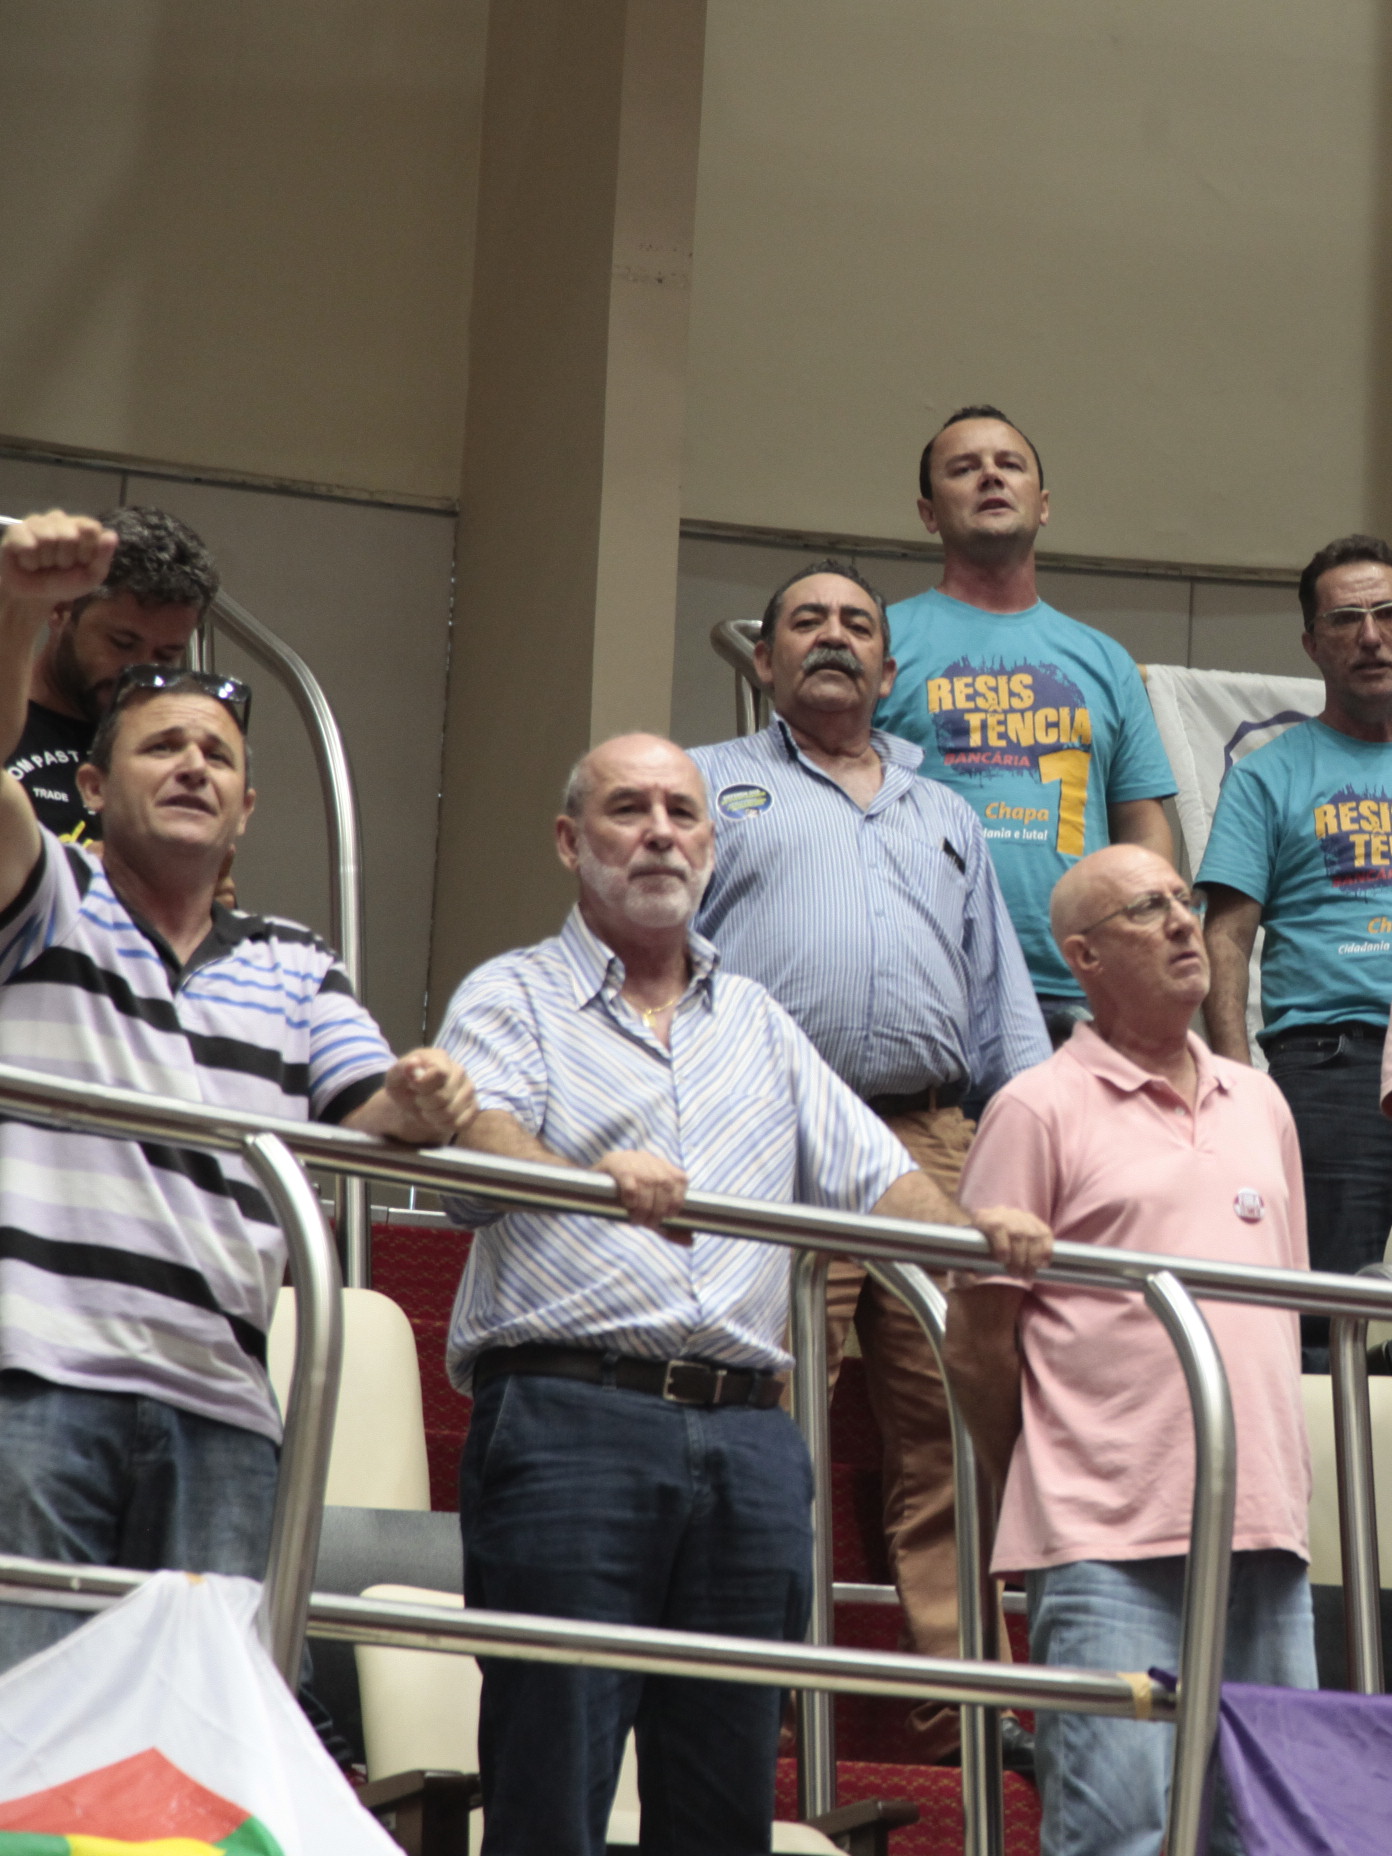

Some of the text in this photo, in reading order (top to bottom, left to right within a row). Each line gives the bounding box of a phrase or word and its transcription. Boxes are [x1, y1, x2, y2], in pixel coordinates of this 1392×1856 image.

[927, 673, 1035, 714] RESIS
[964, 703, 1092, 748] TÊNCIA
[944, 752, 1030, 767] BANCÁRIA
[32, 787, 70, 803] TRADE
[985, 749, 1092, 857] Chapa 1
[1014, 831, 1020, 839] e
[1338, 940, 1390, 954] Cidadania
